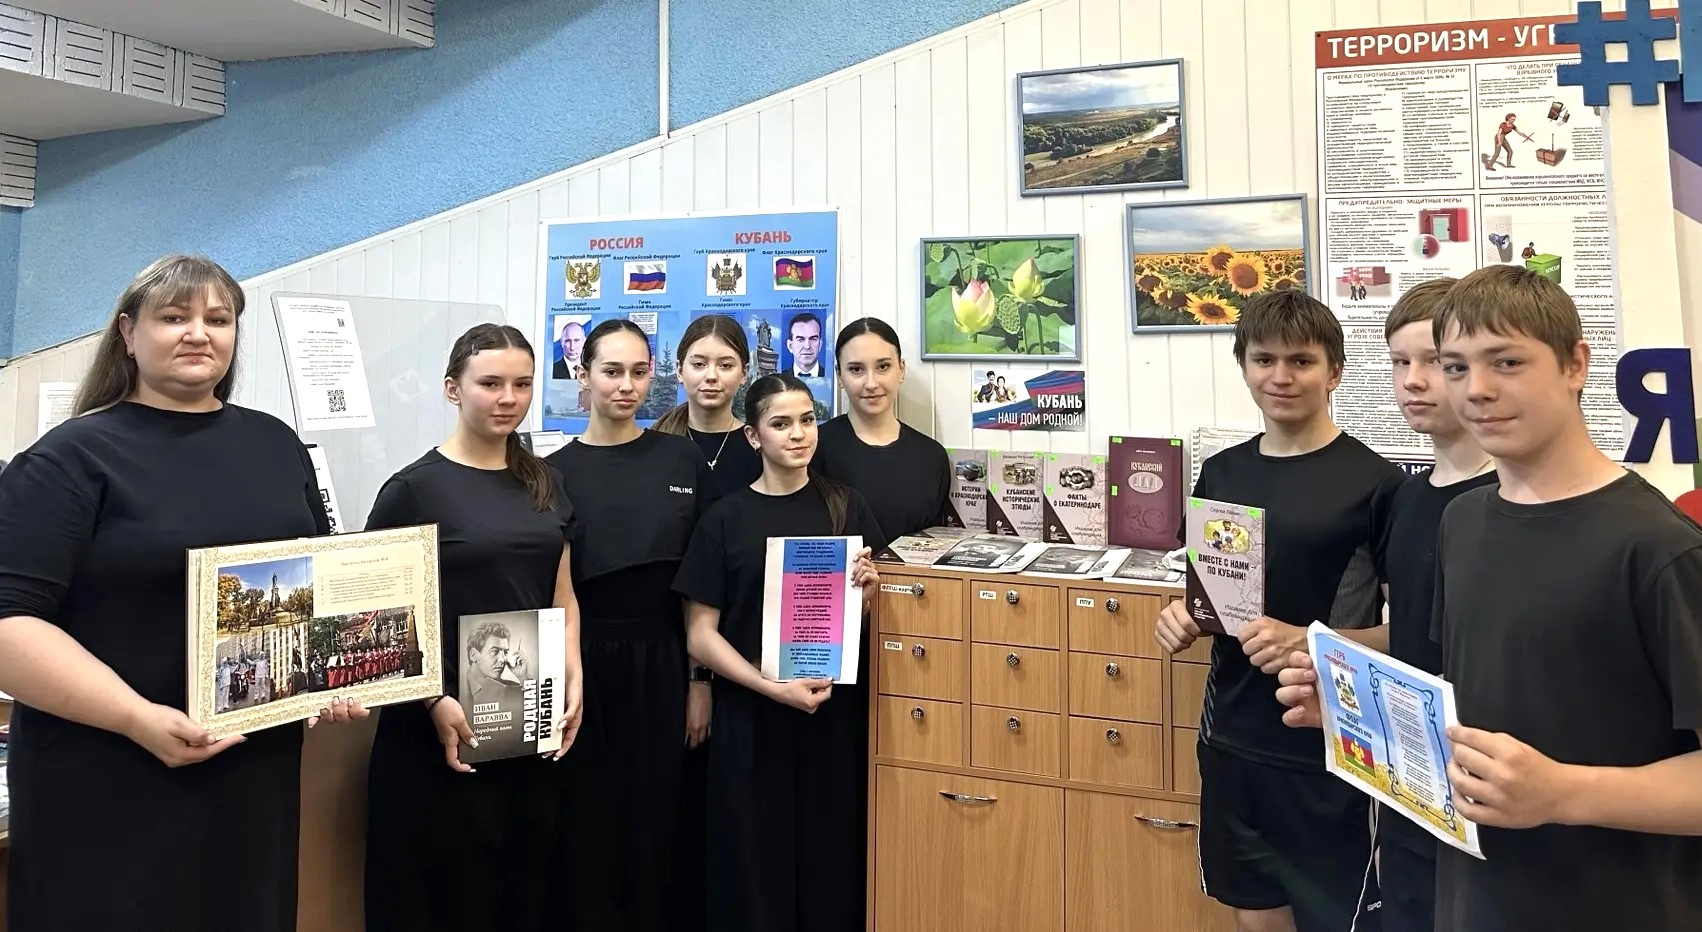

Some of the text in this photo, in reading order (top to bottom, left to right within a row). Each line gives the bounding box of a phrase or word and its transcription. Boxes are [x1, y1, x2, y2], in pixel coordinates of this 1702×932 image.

[1327, 28, 1489, 59] ТЕРРОРИЗМ
[1364, 70, 1425, 78] ПРОТИВОДЕЙСТВИЮ
[589, 236, 644, 250] РОССИЯ
[735, 231, 792, 244] КУБАНЬ
[1037, 394, 1083, 409] КУБАНЬ
[1616, 348, 1700, 464] Я
[998, 412, 1018, 424] НАШ
[1020, 412, 1040, 426] ДОМ
[1042, 412, 1083, 428] РОДНОЙ!
[669, 486, 693, 494] DARLING
[1058, 500, 1101, 509] ЕКАТЕРИНОДАРЕ
[1198, 554, 1250, 571] ВМЕСТЕ С НАМИ
[1207, 566, 1246, 581] ПО КУБАНИ!
[475, 704, 496, 712] ИВАН
[523, 679, 539, 742] РОДНАЯ
[540, 678, 553, 740] КУБАНЬ
[475, 714, 509, 724] ВАРАВВА
